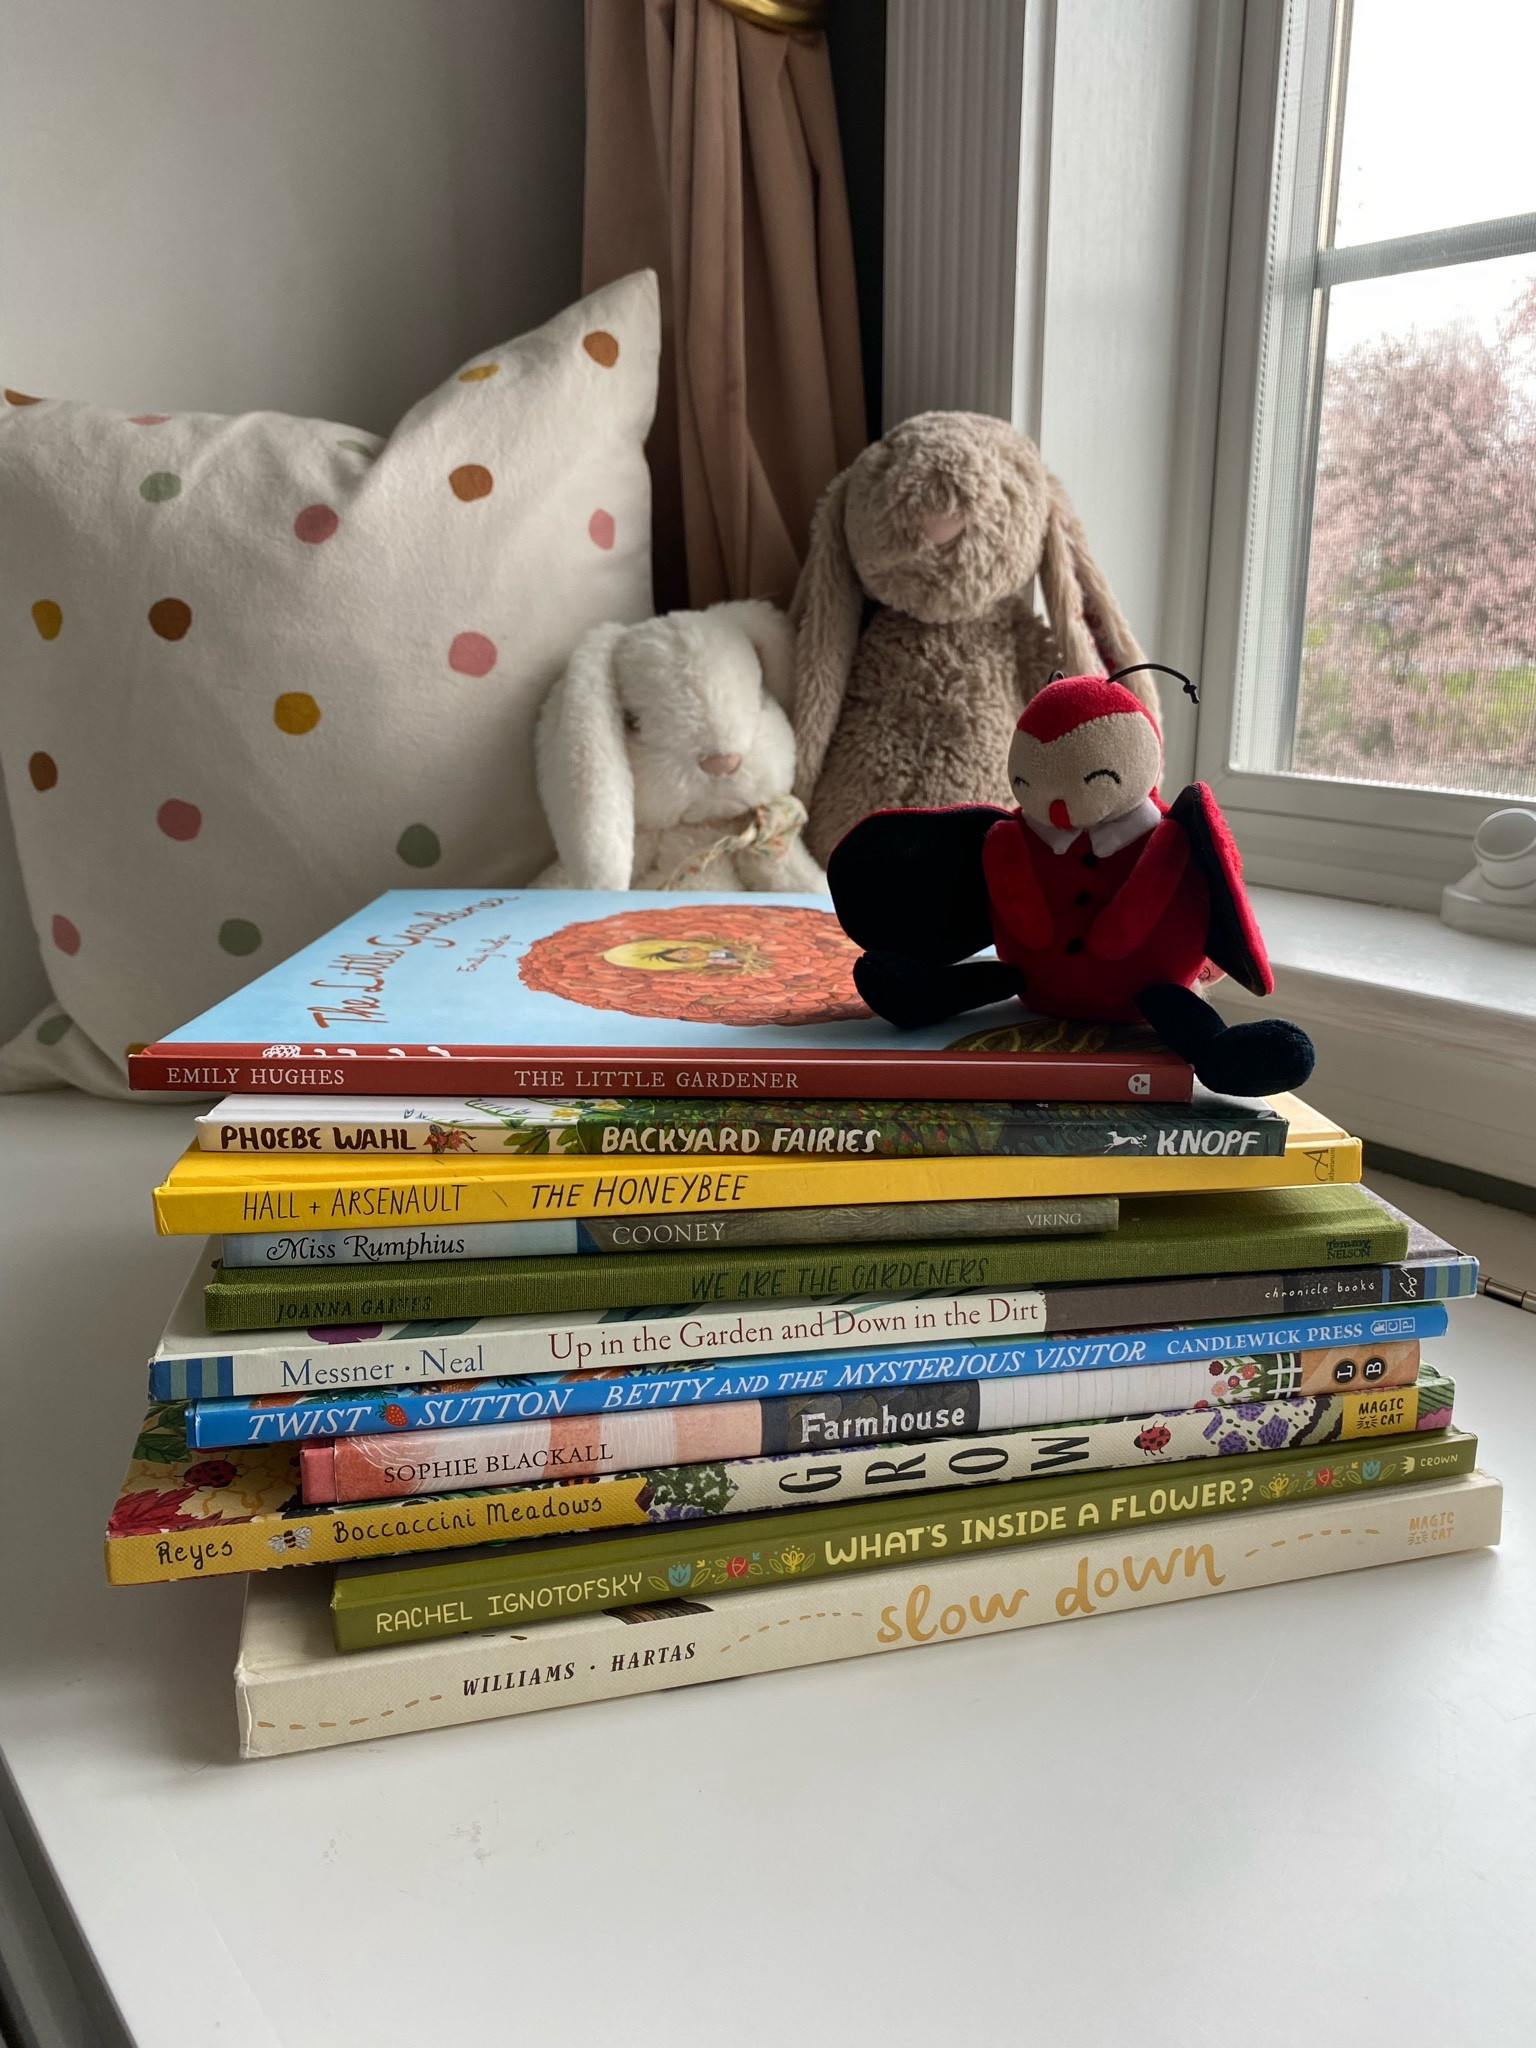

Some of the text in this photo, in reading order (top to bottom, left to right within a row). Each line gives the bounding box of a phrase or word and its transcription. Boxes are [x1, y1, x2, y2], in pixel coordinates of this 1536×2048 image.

[307, 896, 520, 1028] The Little Gardener
[167, 1067, 345, 1085] EMILY HUGHES
[514, 1069, 799, 1089] THE LITTLE GARDENER
[220, 1125, 417, 1151] PHOEBE WAHL
[601, 1127, 881, 1154] BACKYARD FAIRIES
[1156, 1129, 1261, 1156] KNOPF
[243, 1190, 300, 1221] HALL
[331, 1184, 468, 1217] ARSENAULT
[530, 1174, 750, 1209] THE HONEYBEE
[612, 1222, 726, 1246] COONEY
[1026, 1213, 1082, 1227] VIKING
[266, 1232, 466, 1262] Miss Rumphius
[1326, 1247, 1371, 1260] NELSON
[691, 1258, 989, 1300] WE ARE THE GARDENERS
[1264, 1281, 1376, 1299] chronicle books
[275, 1295, 432, 1323] JOANNA GAINES
[548, 1298, 1039, 1369] Up in the Garden and Down in the Dirt
[1166, 1323, 1363, 1356] CANDLEWICK PRESS
[280, 1358, 395, 1388] Messner
[419, 1345, 485, 1376] Neal
[602, 1340, 1147, 1409] BETTY AND THE MYSTERIOUS VISITOR
[247, 1388, 574, 1441] TWIST SUTTON
[1358, 1397, 1405, 1416] MAGIC
[1379, 1413, 1405, 1427] CAT
[800, 1404, 966, 1444] Farmhouse
[384, 1444, 614, 1484] SOPHIE BLACKALL
[779, 1436, 1090, 1494] GROW
[1420, 1453, 1459, 1468] CROWN
[333, 1496, 602, 1543] Boccaccini Meadows
[824, 1477, 1255, 1567] WHAT'S INSIDE A FLOWER?
[1408, 1511, 1455, 1532] MAGIC
[1430, 1527, 1455, 1541] CAT
[155, 1538, 233, 1570] Reyes
[376, 1572, 643, 1634] RACHEL IGNOTOFSKY
[876, 1543, 1226, 1643] slow down
[462, 1661, 576, 1697] WILLIAMS
[610, 1642, 697, 1673] HARTAS
